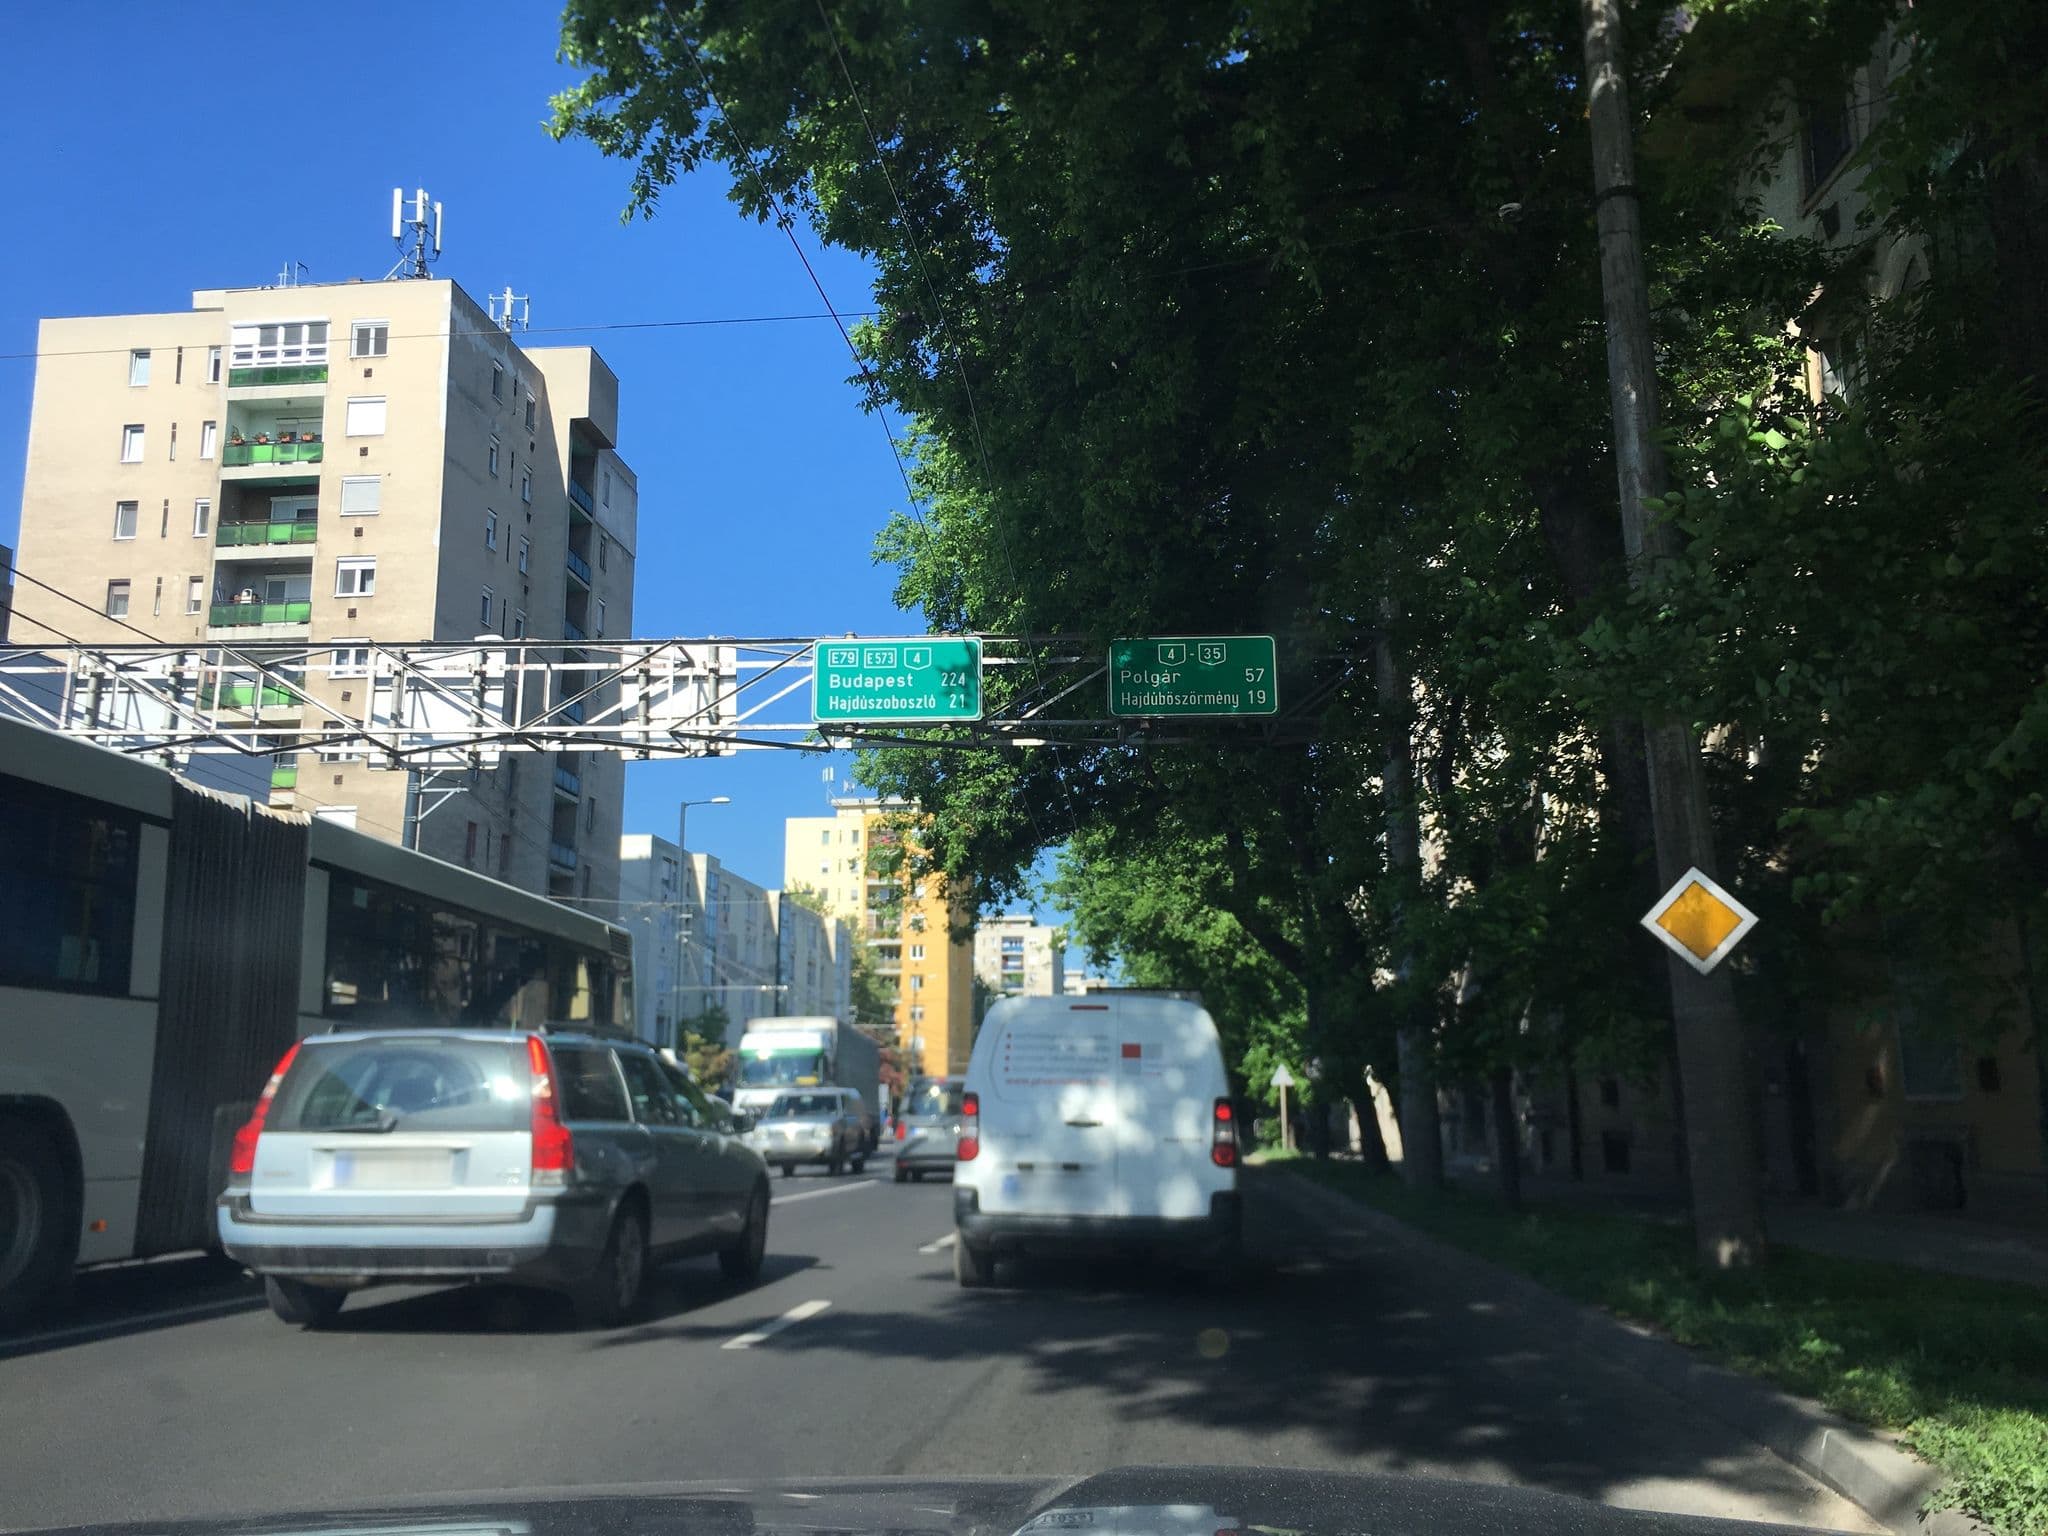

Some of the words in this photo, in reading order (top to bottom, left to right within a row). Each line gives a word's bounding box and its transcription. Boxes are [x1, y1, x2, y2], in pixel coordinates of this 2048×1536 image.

[831, 651, 855, 664] E79
[912, 652, 921, 663] 4
[1167, 648, 1175, 660] 4
[1203, 647, 1221, 660] 35
[830, 672, 913, 691] Budapest
[941, 672, 966, 687] 224
[1120, 669, 1181, 687] Polgár
[1245, 668, 1265, 682] 57
[829, 693, 936, 713] Hajdúszoboszló
[949, 694, 965, 708] 21
[1121, 690, 1239, 708] Hajdúböszörmény
[1247, 690, 1266, 704] 19
